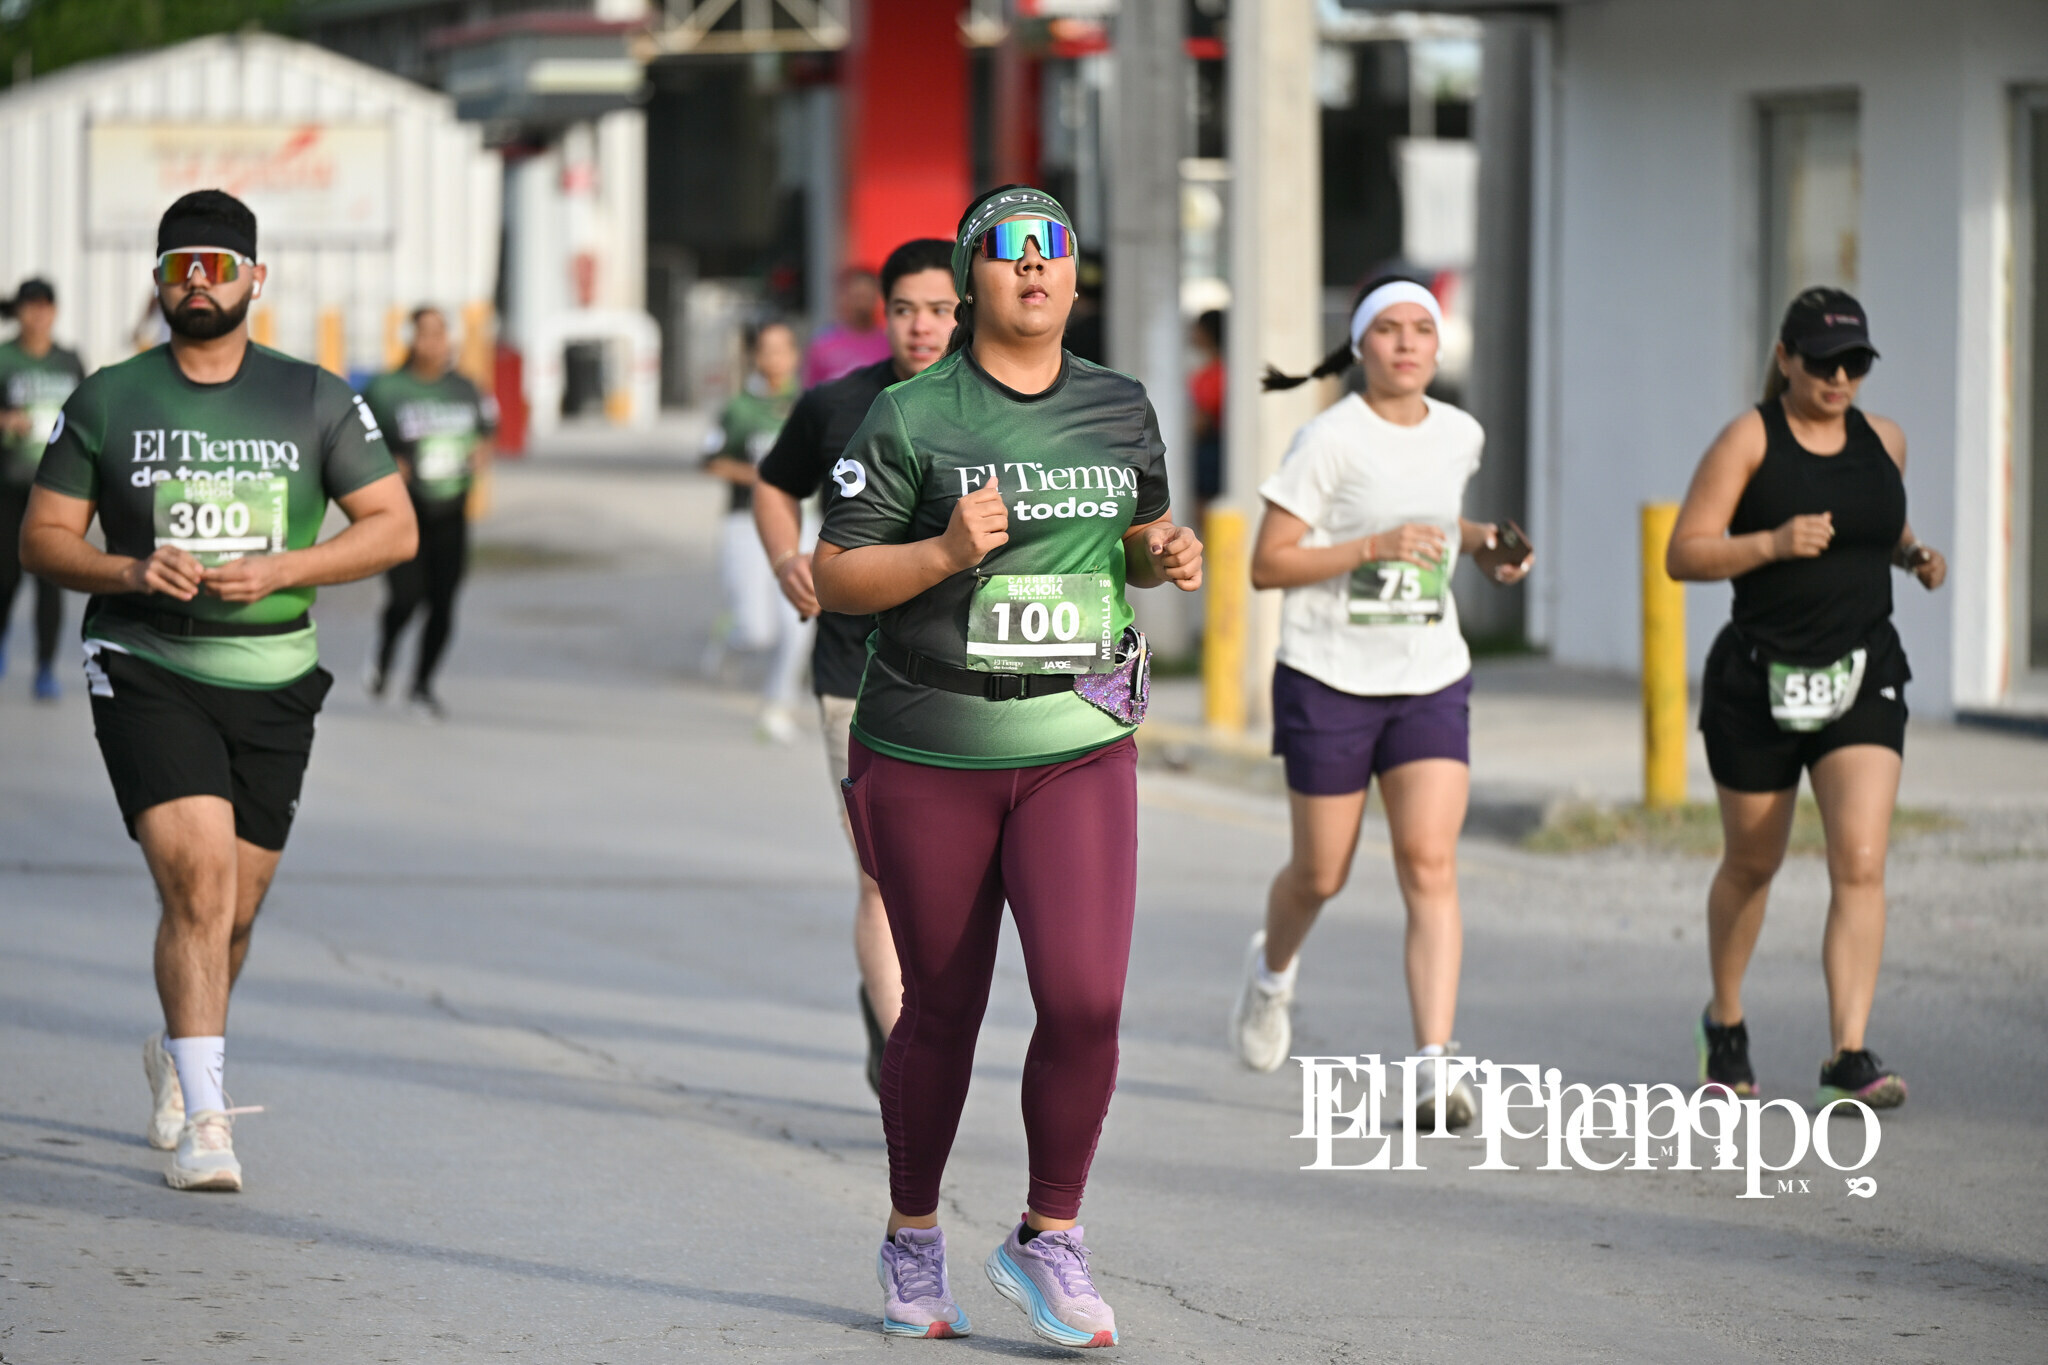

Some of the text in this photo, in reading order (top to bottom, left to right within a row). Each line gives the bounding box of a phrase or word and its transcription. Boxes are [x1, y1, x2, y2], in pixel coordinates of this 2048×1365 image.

[131, 429, 299, 470] El Tiempo
[1004, 462, 1137, 498] Tiempo
[169, 502, 250, 538] 300
[1013, 497, 1119, 521] todos
[1007, 576, 1063, 585] CARRERA
[1377, 568, 1422, 602] 75
[991, 601, 1080, 642] 100
[1101, 594, 1111, 660] MEDALLA
